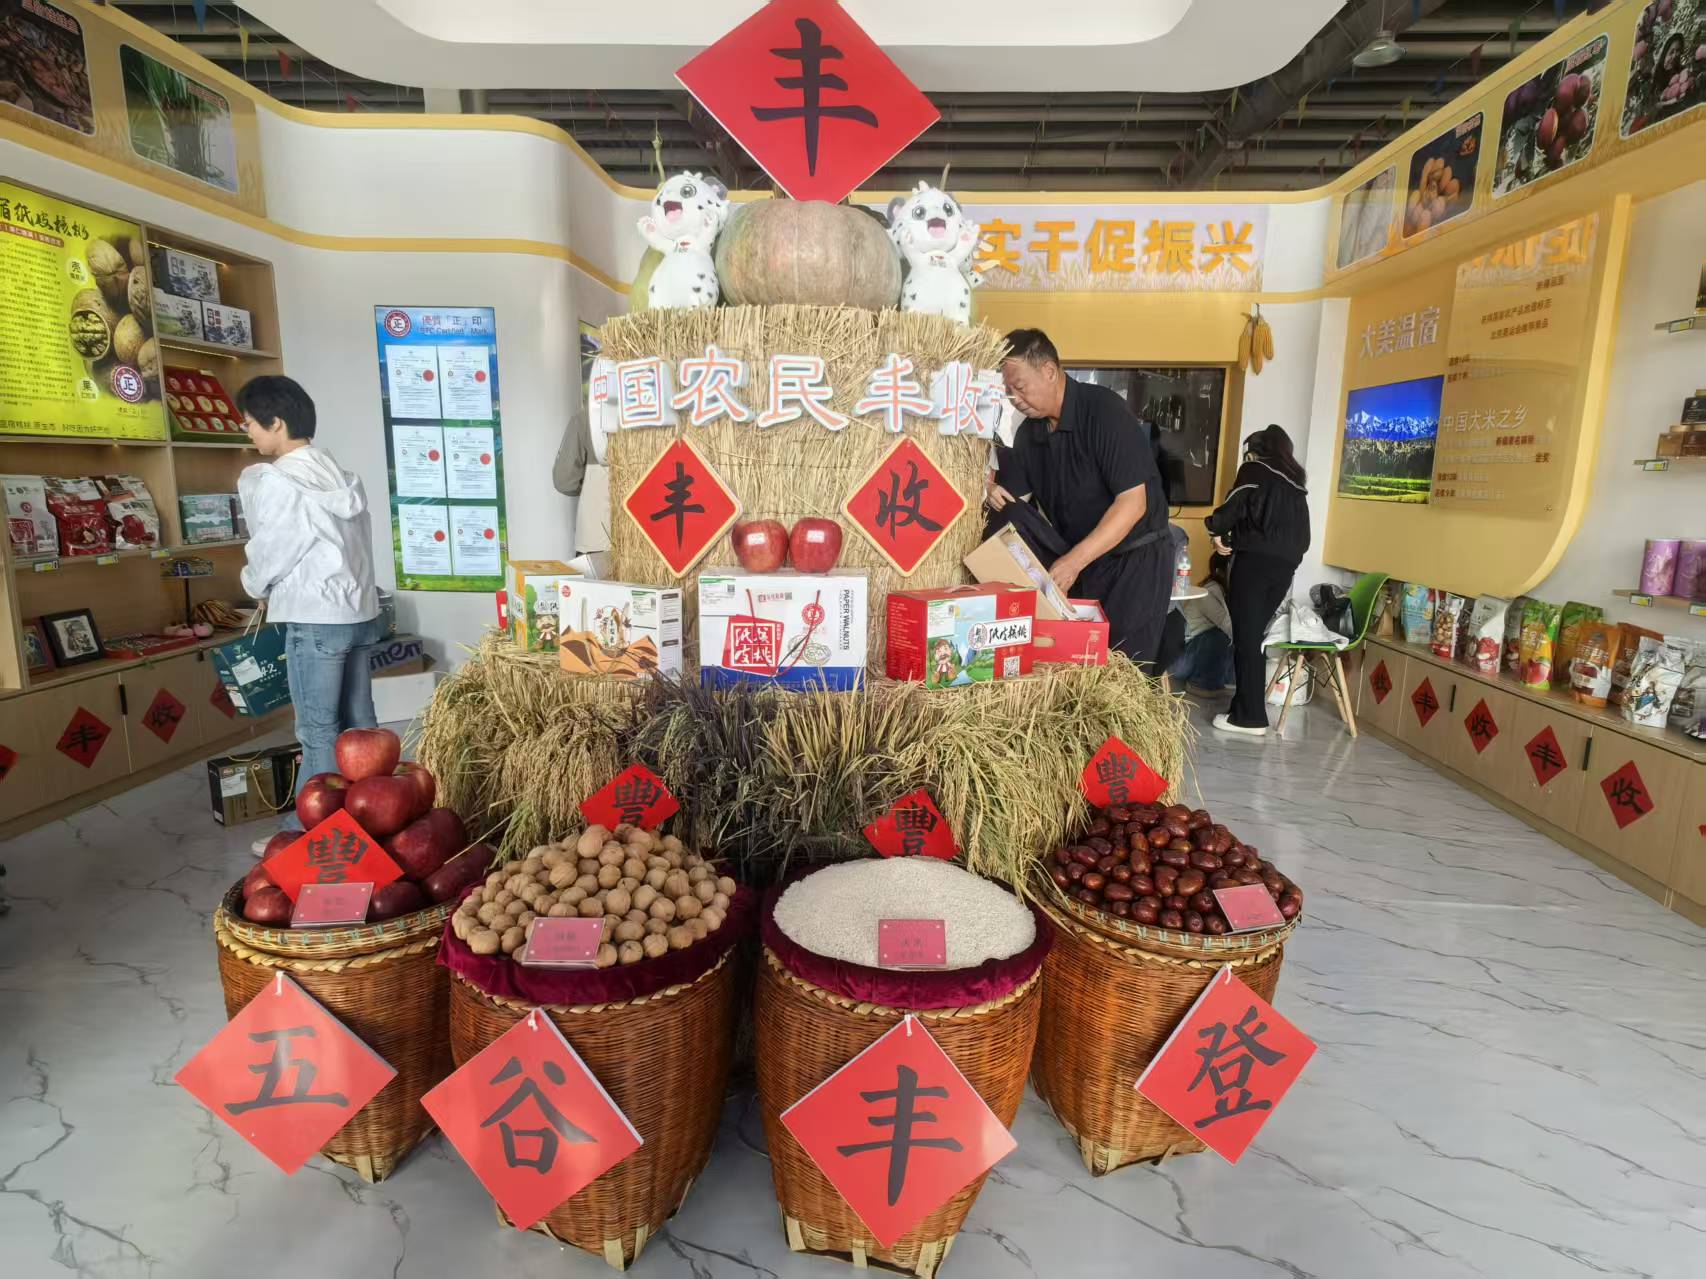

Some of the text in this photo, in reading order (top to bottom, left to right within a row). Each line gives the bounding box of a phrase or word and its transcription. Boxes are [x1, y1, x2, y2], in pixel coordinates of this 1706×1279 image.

[751, 18, 879, 177] 丰
[973, 218, 1254, 274] 实干促振兴
[1360, 305, 1440, 360] 大美温宿
[1443, 404, 1528, 433] 中国大米之乡
[650, 461, 705, 549] 丰
[875, 460, 944, 540] 收
[1471, 714, 1494, 741] 收
[1531, 742, 1561, 770] 丰
[1610, 777, 1644, 815] 收
[224, 1026, 349, 1116] 五
[1187, 1005, 1288, 1129] 登
[480, 1056, 598, 1175] 谷
[837, 1065, 964, 1207] 丰
